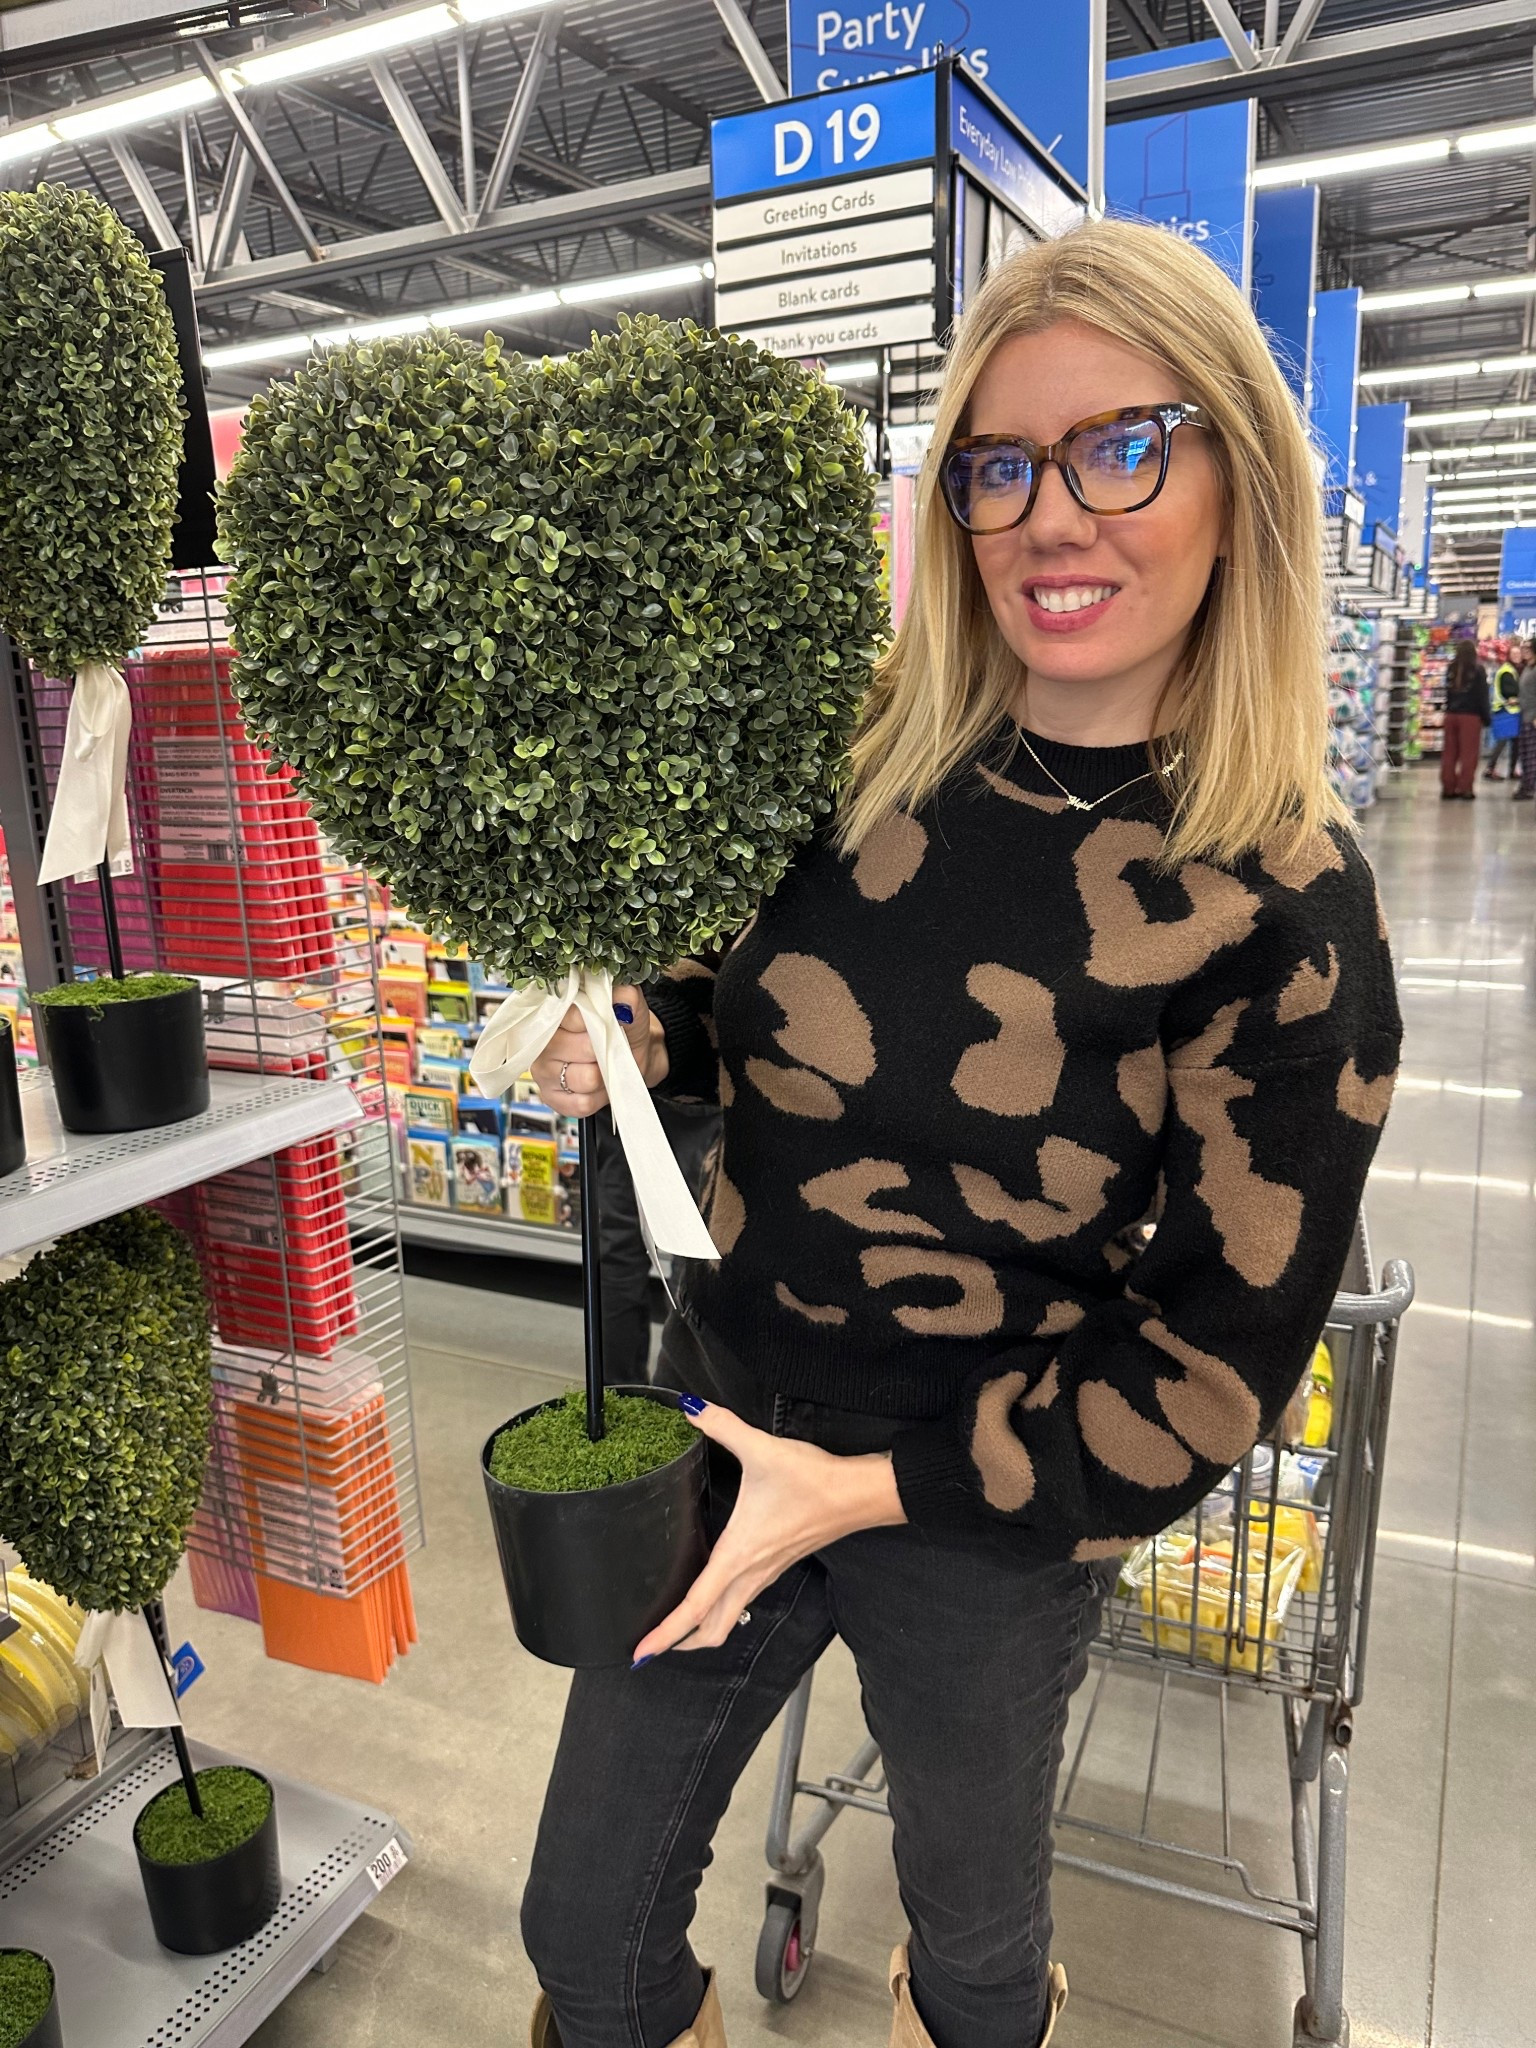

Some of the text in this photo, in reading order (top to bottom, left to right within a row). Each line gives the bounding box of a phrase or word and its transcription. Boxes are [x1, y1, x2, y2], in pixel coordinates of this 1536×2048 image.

[817, 1, 926, 56] Party
[774, 103, 881, 177] D 19
[960, 105, 1000, 173] Everyday
[763, 191, 876, 225] Greeting Cards
[781, 240, 858, 266] Invitations
[778, 281, 860, 308] Blank cards
[764, 323, 879, 351] Thank you cards
[370, 1852, 392, 1879] 200
